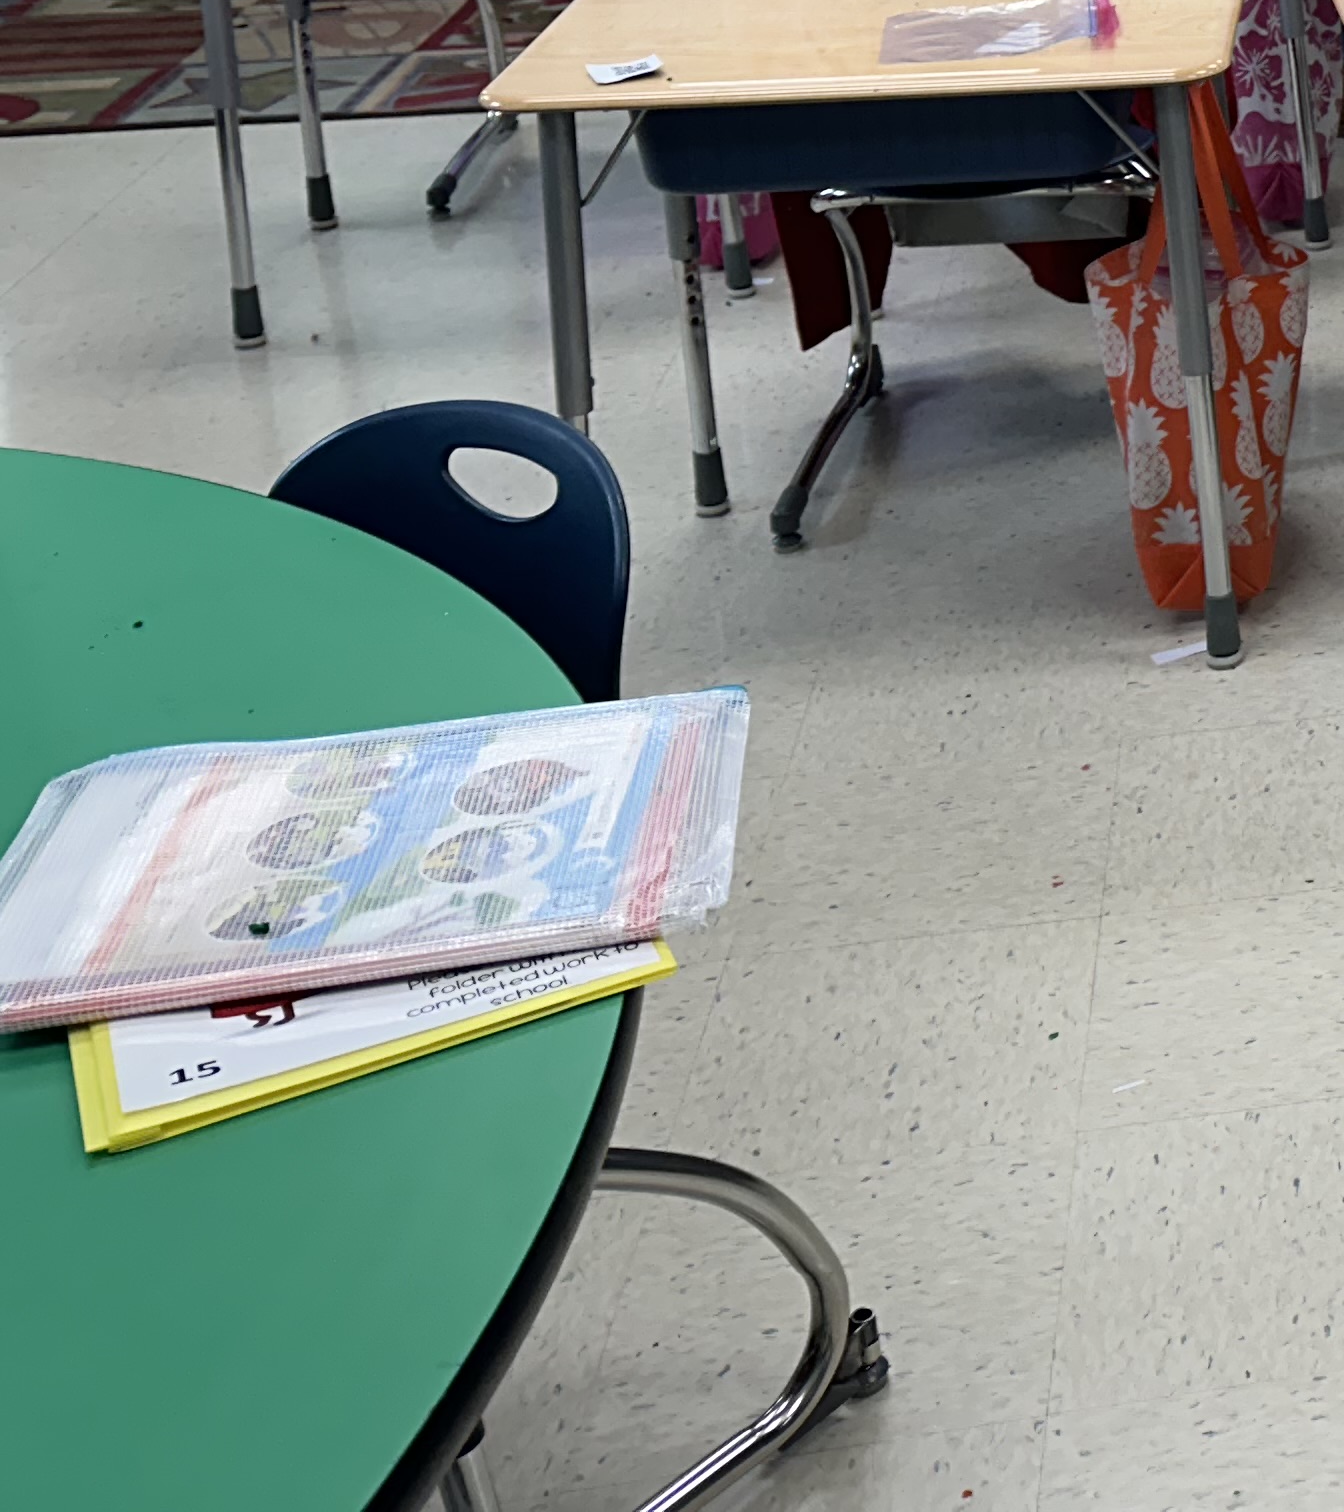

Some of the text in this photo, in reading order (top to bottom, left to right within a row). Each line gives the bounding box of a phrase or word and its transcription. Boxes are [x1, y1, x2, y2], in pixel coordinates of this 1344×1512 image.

[407, 971, 537, 1018] completed
[429, 968, 499, 997] folder
[490, 976, 569, 1007] school
[169, 1060, 222, 1086] 15
